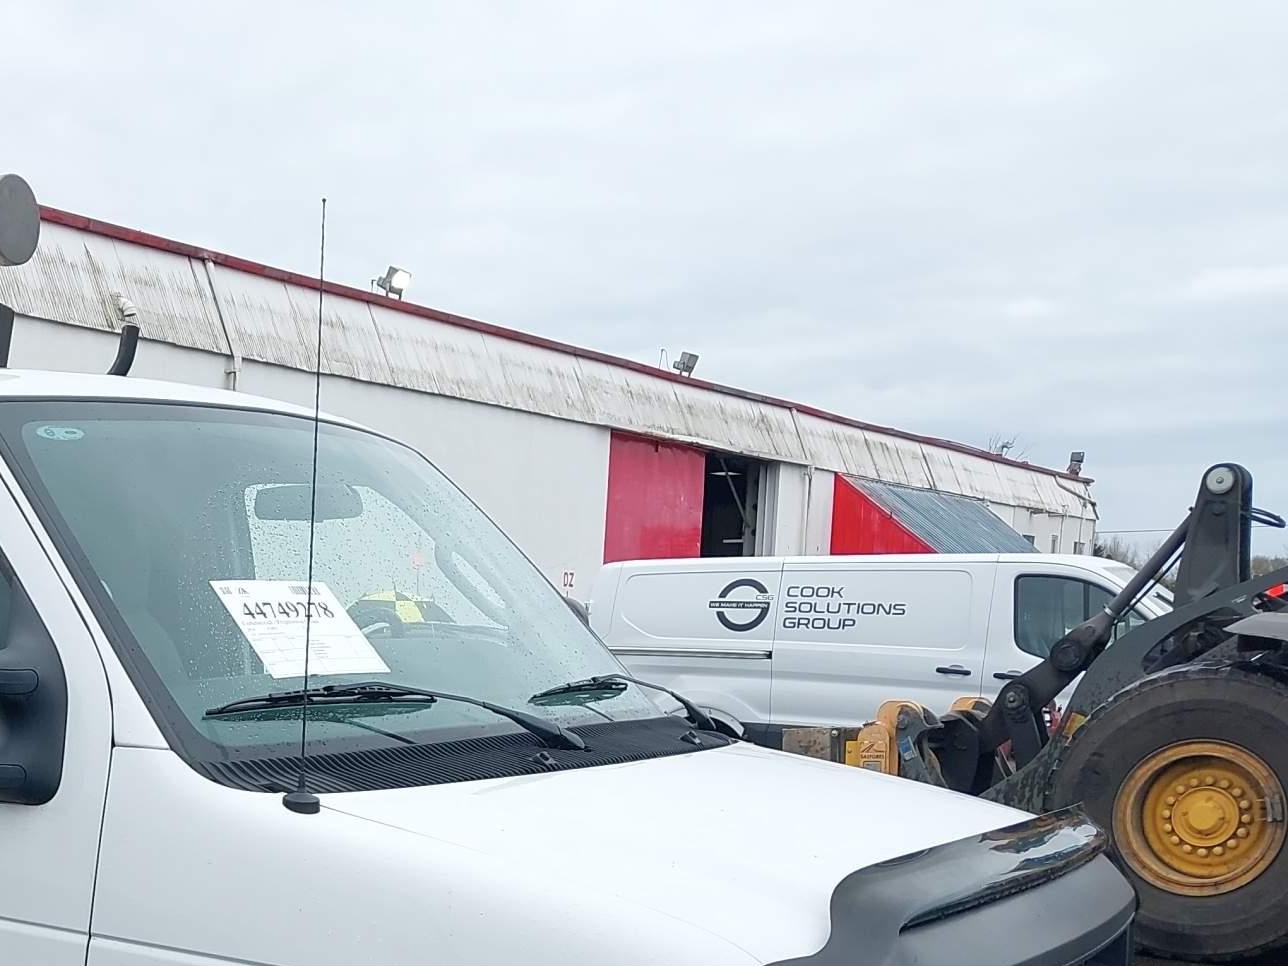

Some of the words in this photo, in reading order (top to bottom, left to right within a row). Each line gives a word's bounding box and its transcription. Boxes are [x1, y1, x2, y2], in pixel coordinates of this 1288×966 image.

[786, 586, 845, 599] COOK
[243, 601, 335, 619] 44749278
[784, 601, 907, 616] SOLUTIONS
[782, 616, 856, 631] GROUP
